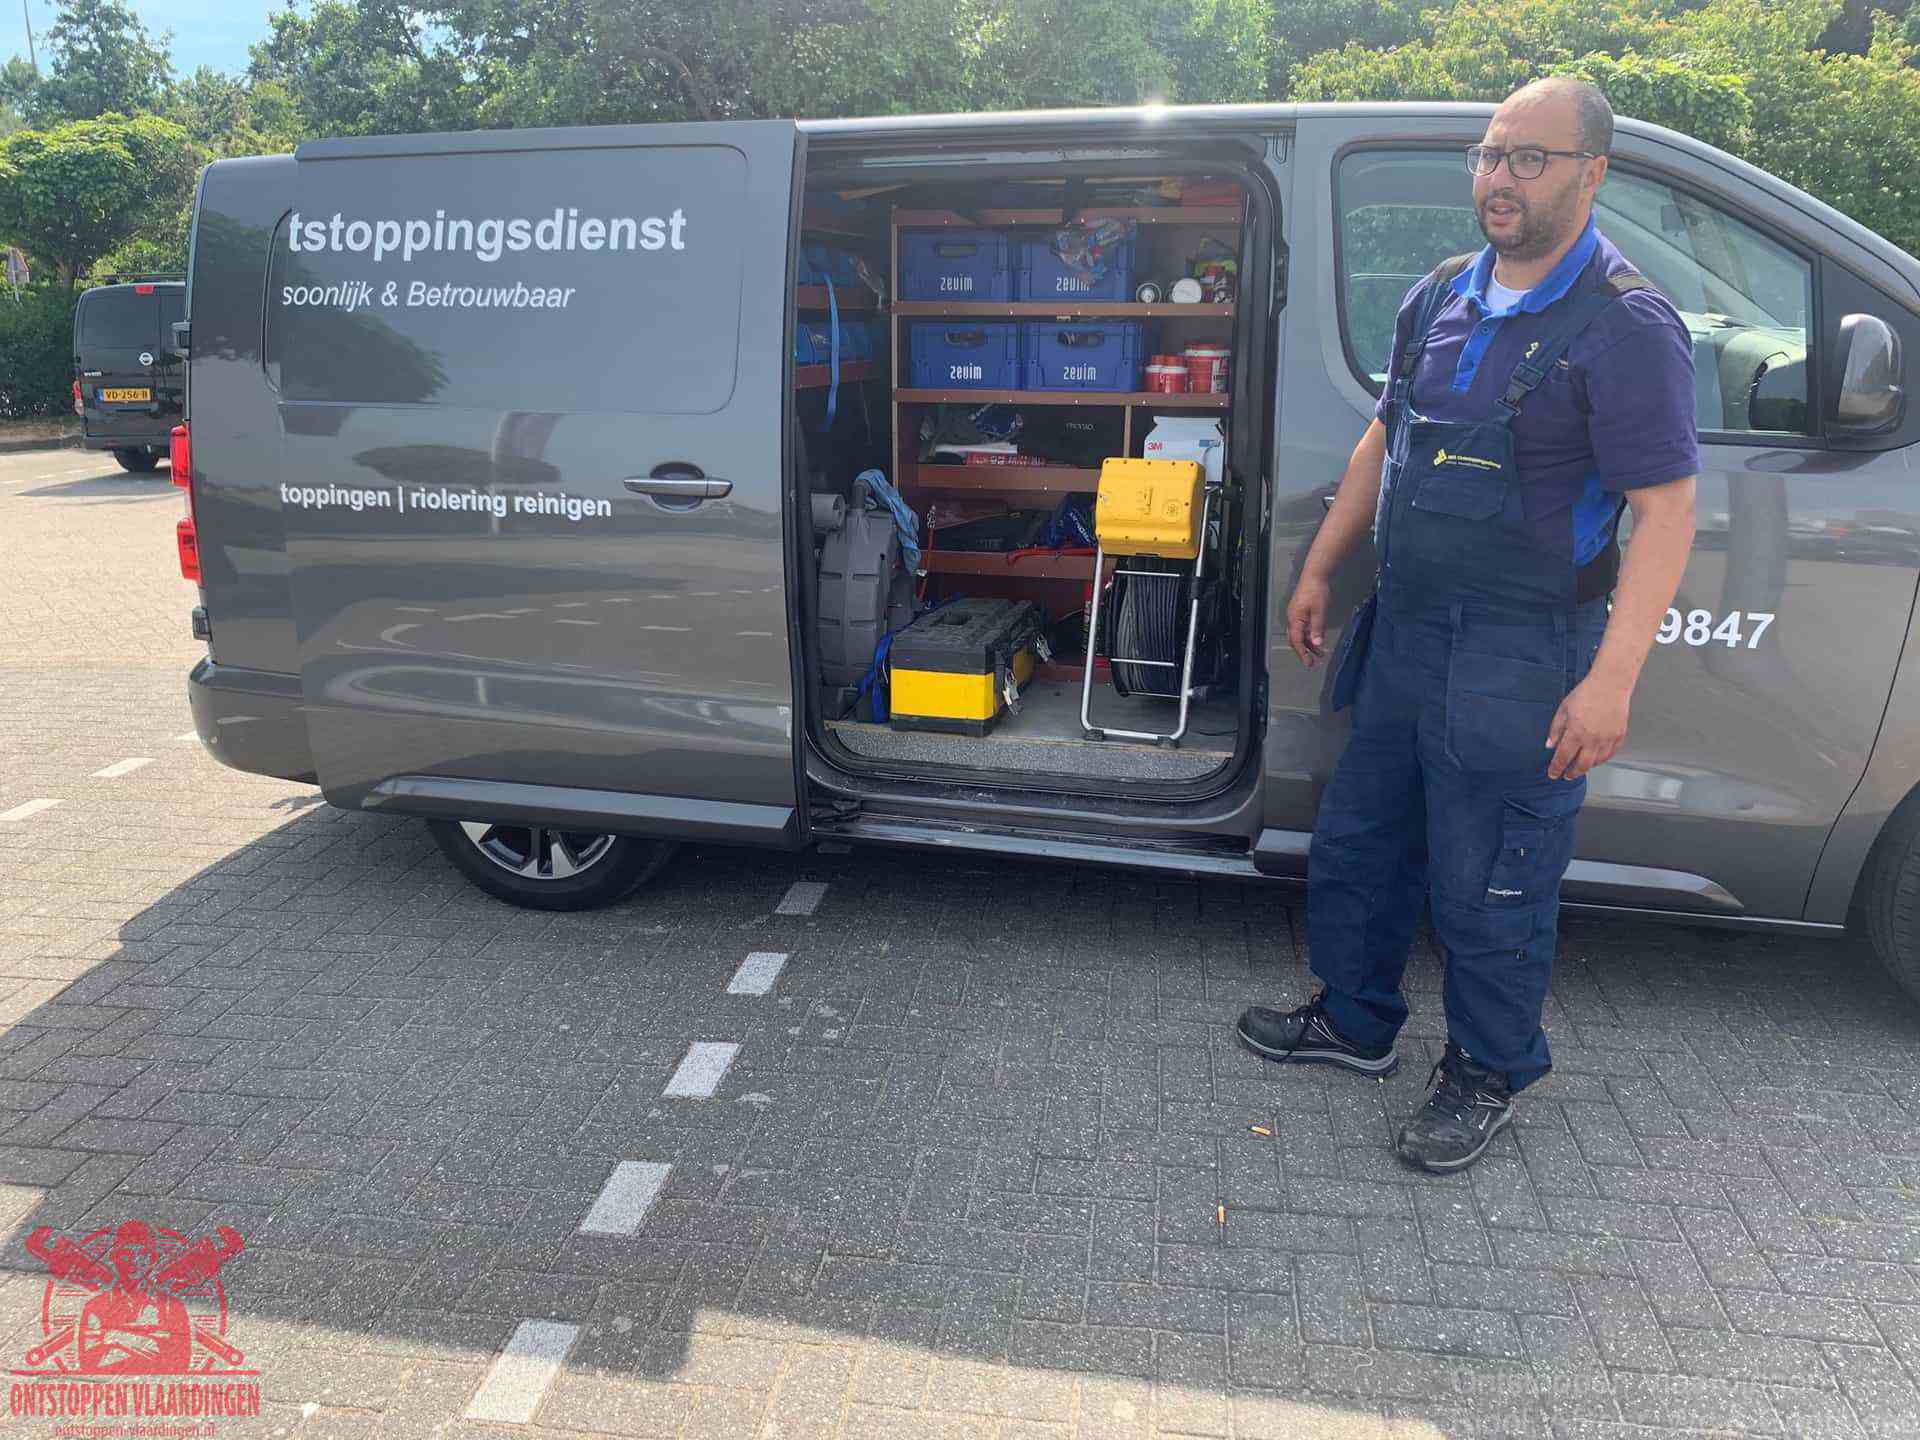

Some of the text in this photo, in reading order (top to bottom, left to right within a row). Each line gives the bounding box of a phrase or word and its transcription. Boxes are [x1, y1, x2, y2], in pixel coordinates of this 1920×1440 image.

[289, 207, 686, 262] tstoppingsdienst
[282, 280, 576, 312] soonlijk & Betrouwbaar
[1147, 441, 1163, 451] 3M
[280, 482, 391, 515] toppingen
[410, 486, 507, 518] riolering
[514, 493, 611, 520] reinigen
[1655, 607, 1775, 649] 9847
